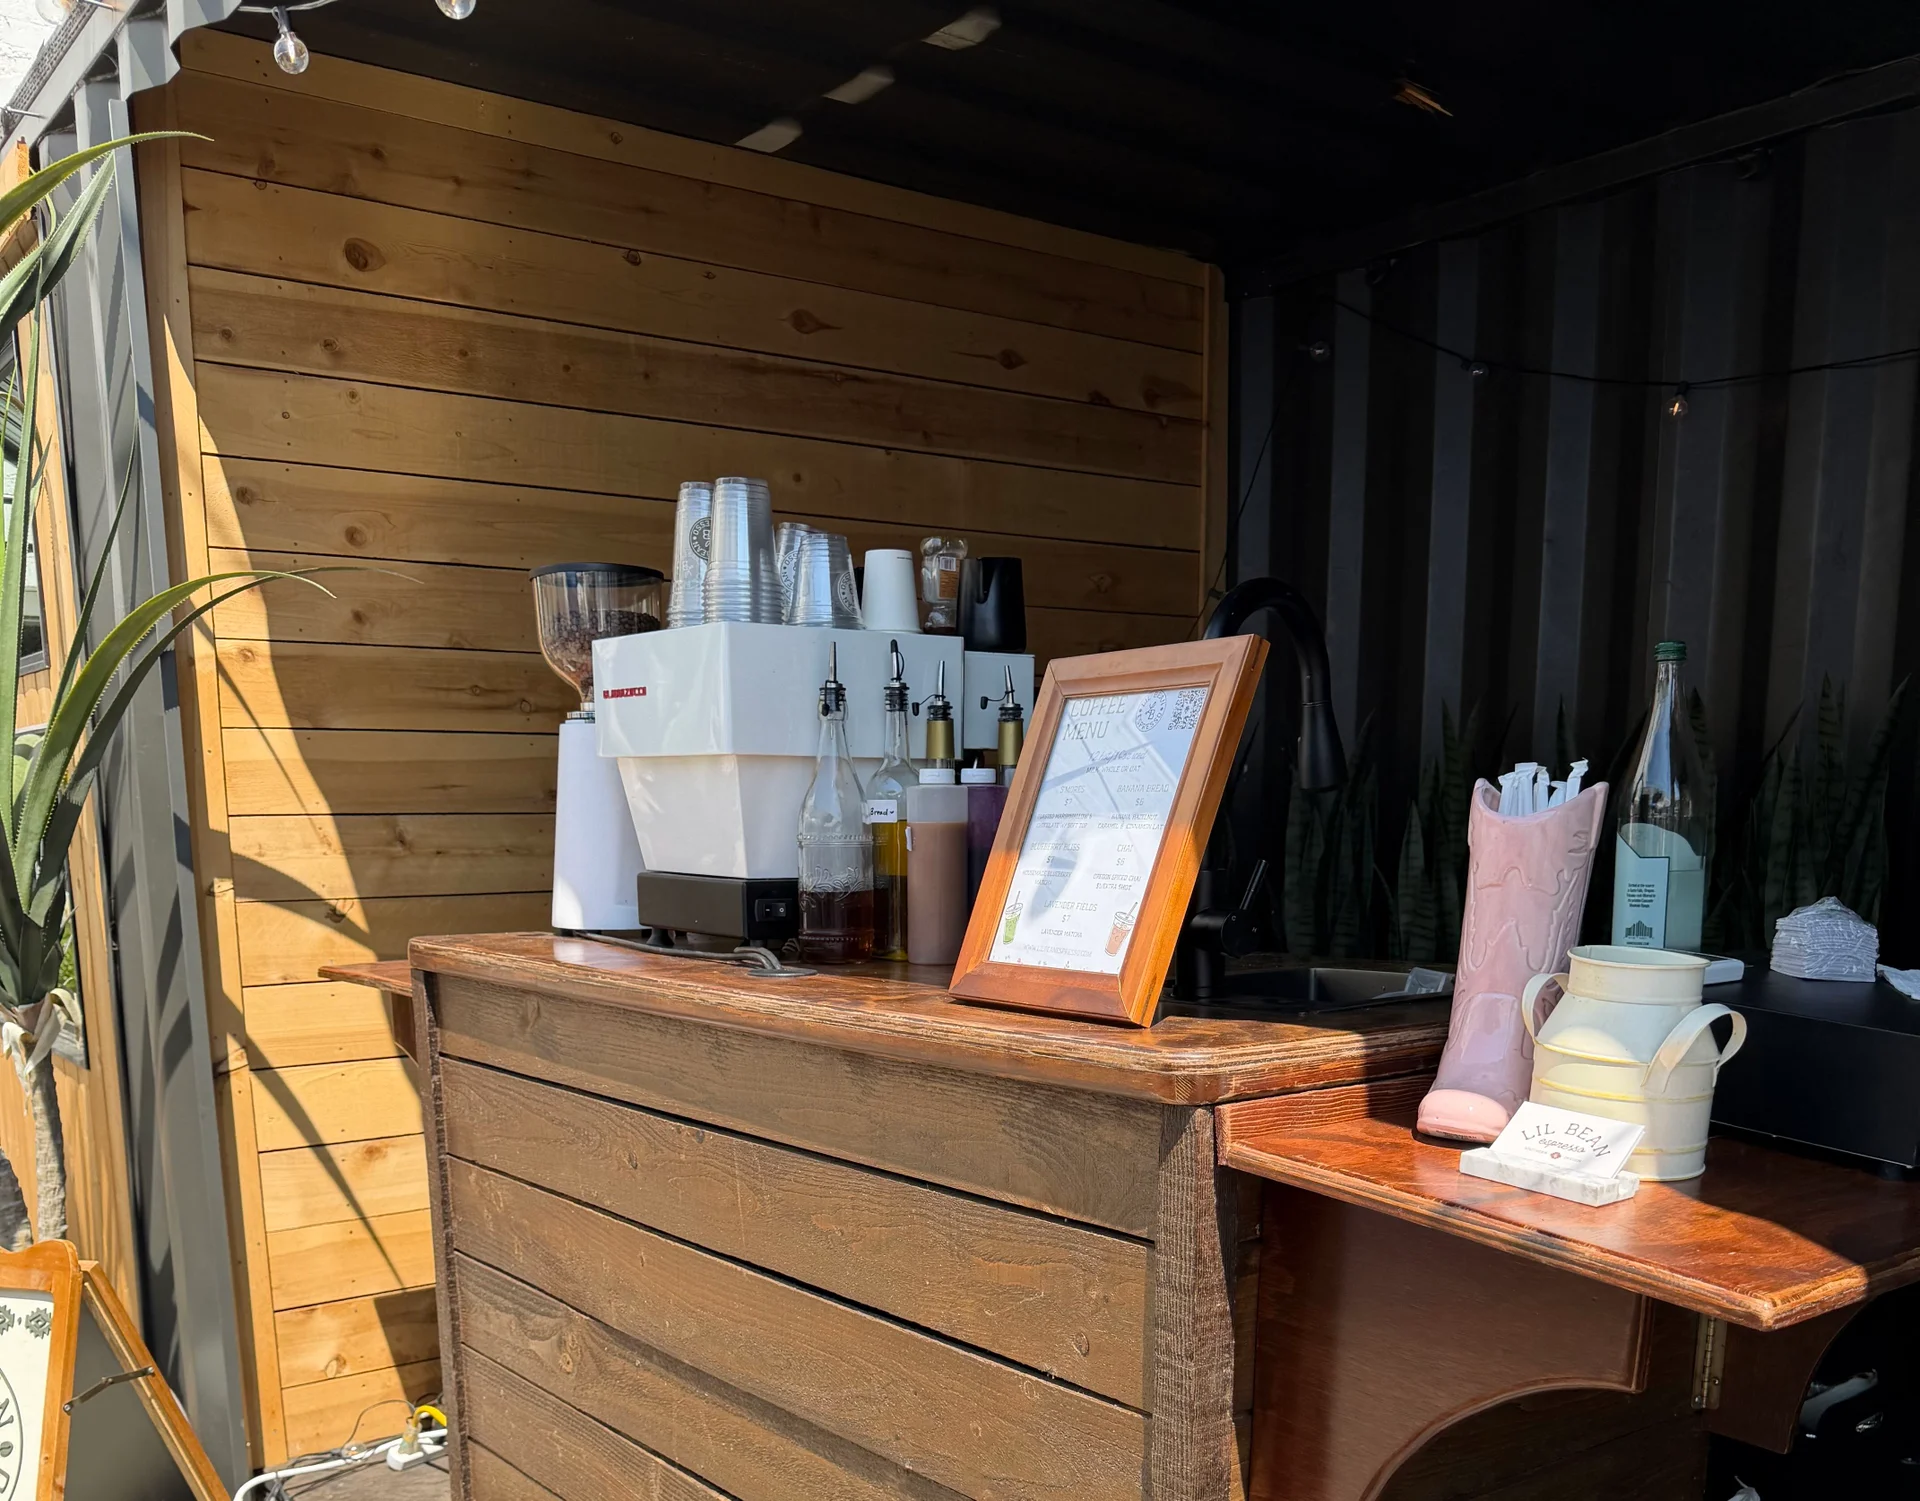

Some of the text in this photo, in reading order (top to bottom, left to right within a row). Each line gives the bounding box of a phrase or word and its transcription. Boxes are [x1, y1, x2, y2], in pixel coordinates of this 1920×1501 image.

[1070, 696, 1125, 717] COFFEE
[1062, 720, 1110, 741] MENU
[1116, 784, 1170, 794] BANANA BREAD
[1030, 841, 1081, 851] BLUEBERRY BLISS
[1116, 843, 1134, 852] CHAI
[1044, 899, 1098, 912] LAVENDER FIELDS
[1522, 1123, 1610, 1157] LIL BEAN
[1538, 1137, 1587, 1154] espresso
